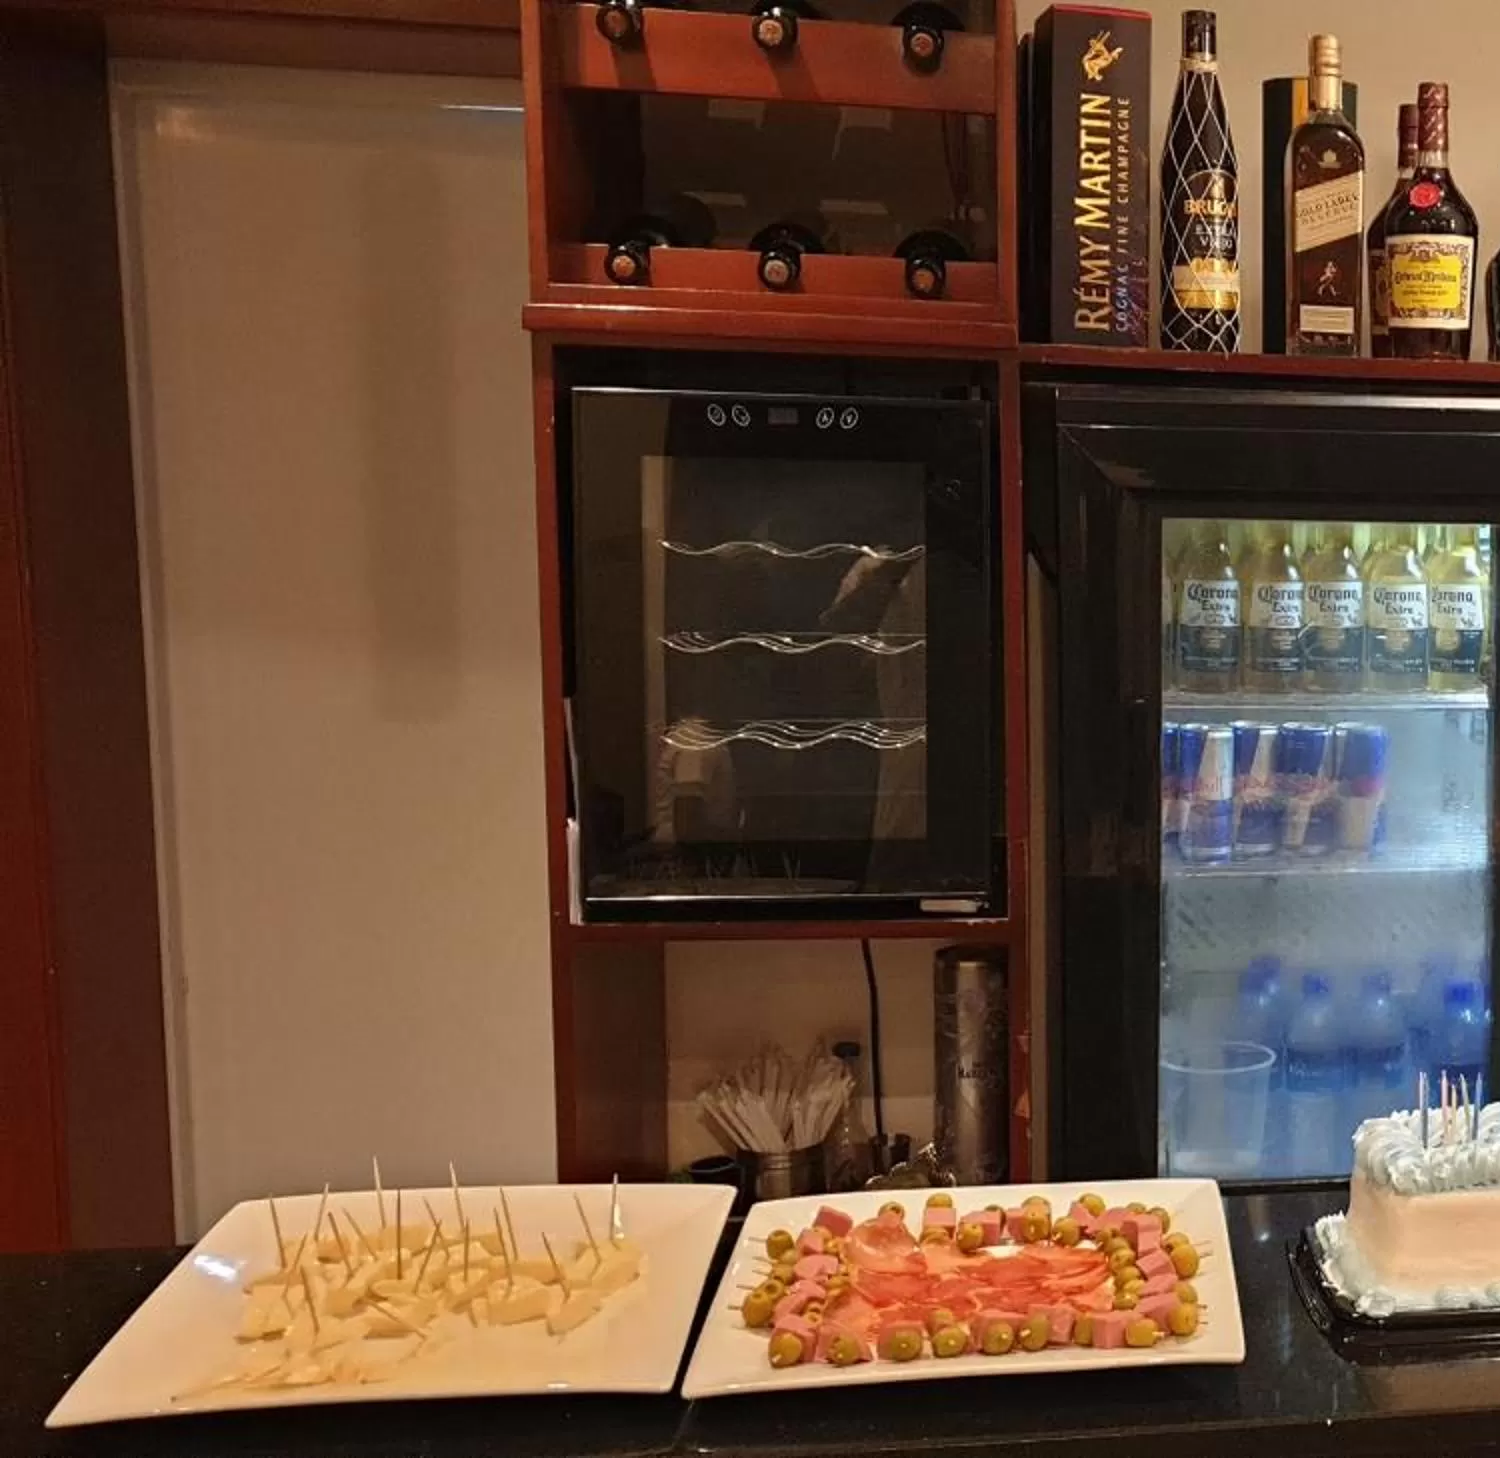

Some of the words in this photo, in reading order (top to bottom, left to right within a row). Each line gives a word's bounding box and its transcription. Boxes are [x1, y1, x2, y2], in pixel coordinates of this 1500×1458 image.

[1074, 93, 1111, 230] MARTIN
[1115, 97, 1131, 205] CHAMPAGNE
[1073, 235, 1110, 332] RÉMY
[1115, 264, 1130, 333] COGNAC
[1187, 582, 1238, 604] Corona
[1308, 583, 1359, 602] Corona
